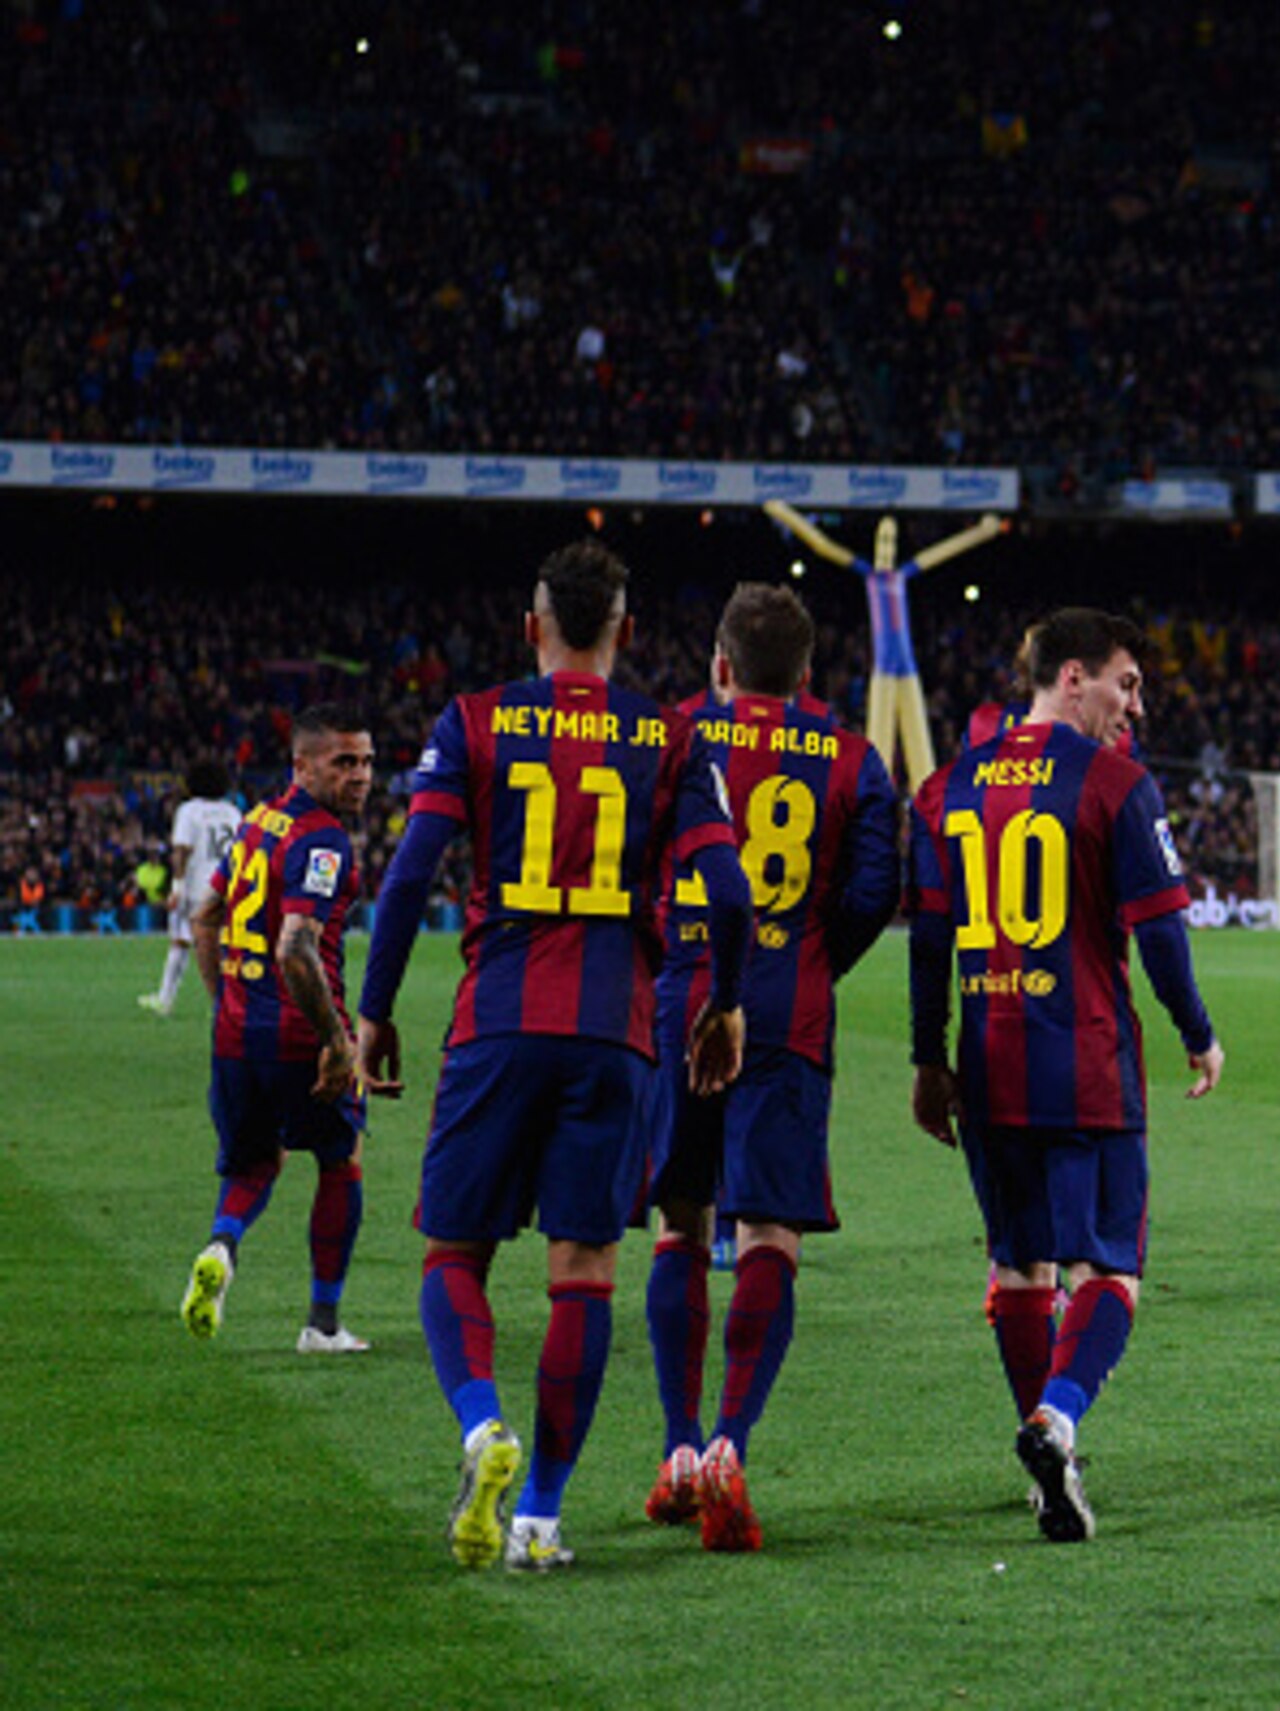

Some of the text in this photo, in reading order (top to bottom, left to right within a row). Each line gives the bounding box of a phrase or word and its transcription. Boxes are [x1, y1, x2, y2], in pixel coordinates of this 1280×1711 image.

[491, 706, 668, 747] NEYMAR JR
[769, 727, 839, 760] ALBA
[973, 757, 1055, 787] MESSI
[501, 761, 631, 916] 11
[944, 809, 1069, 949] 10
[960, 969, 1021, 995] unicef
